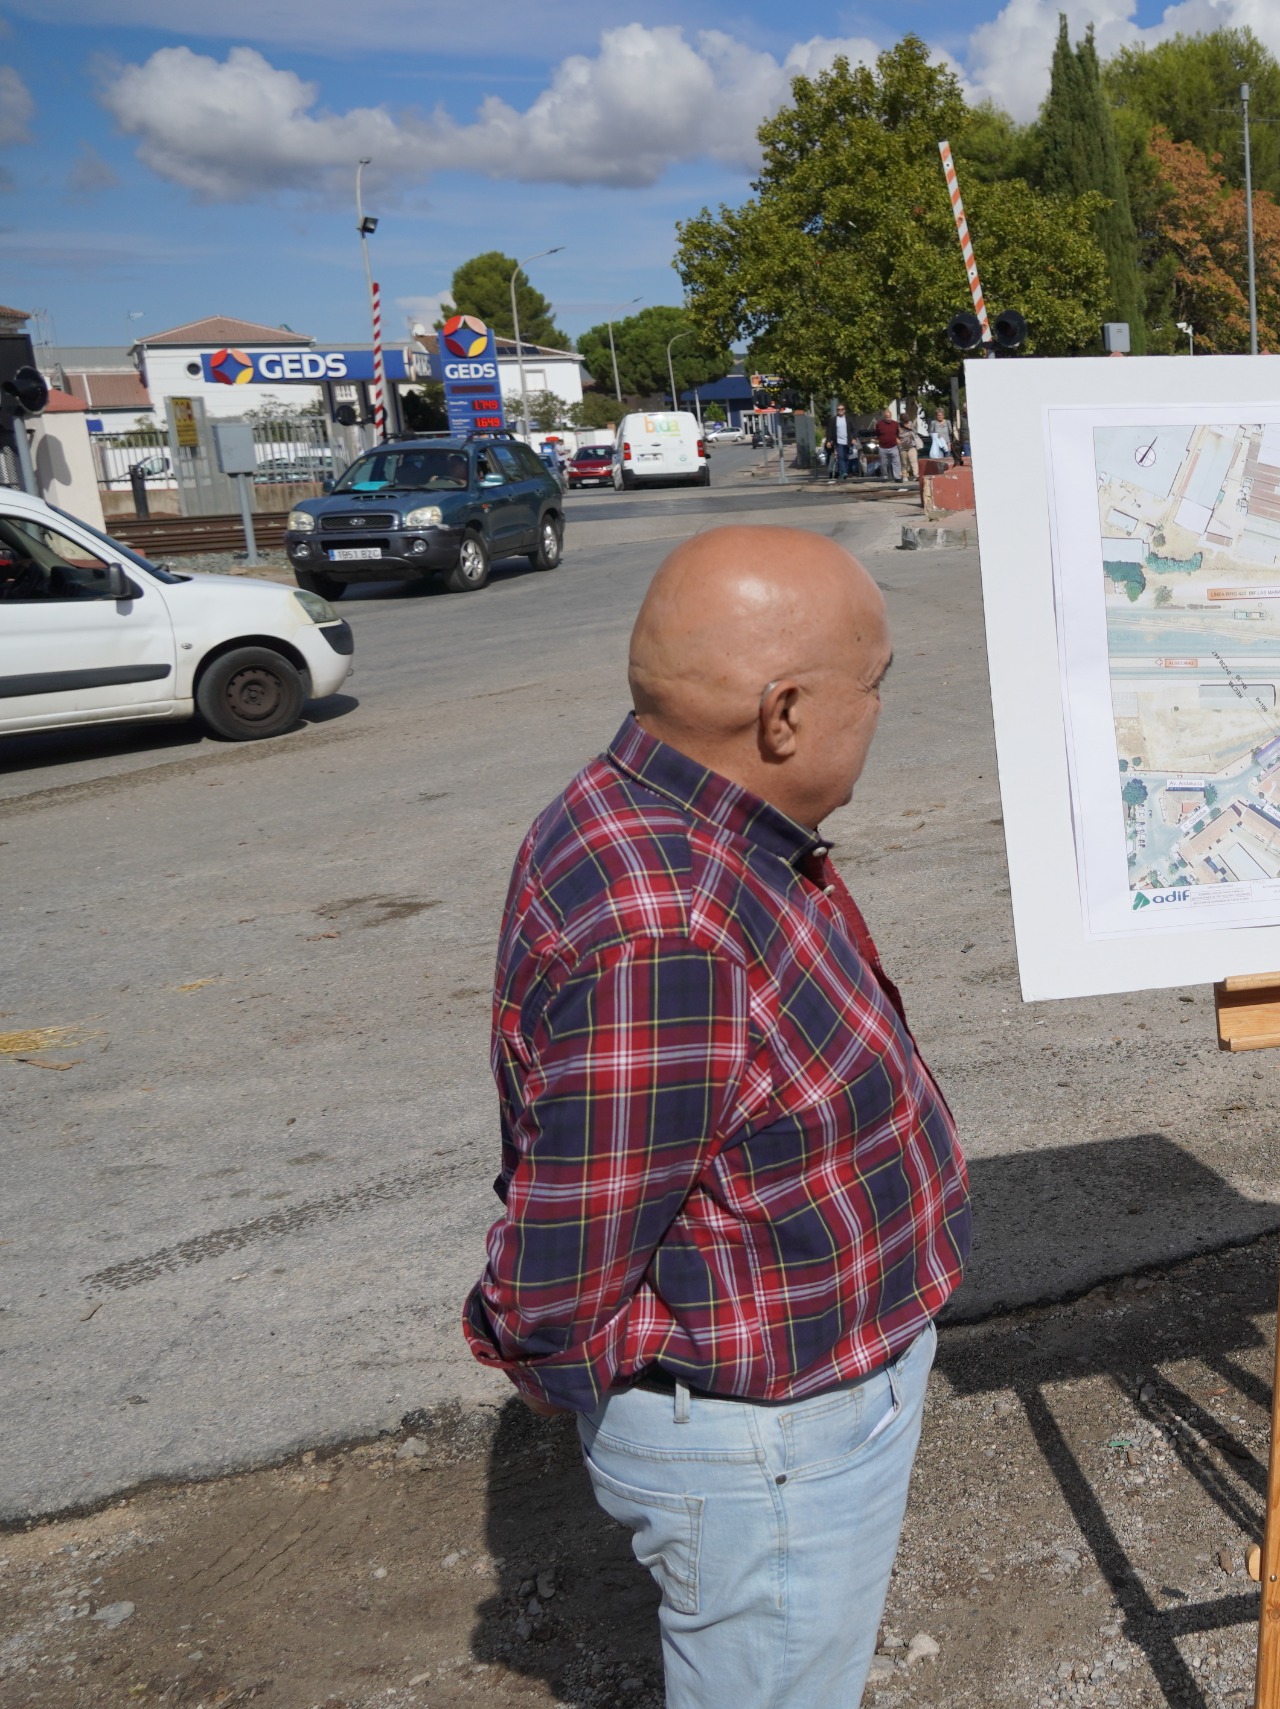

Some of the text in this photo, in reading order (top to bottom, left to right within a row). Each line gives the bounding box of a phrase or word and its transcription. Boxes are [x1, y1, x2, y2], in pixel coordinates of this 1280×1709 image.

[258, 353, 347, 379] GEDS
[445, 363, 496, 379] GEDS
[1152, 889, 1190, 904] adif
